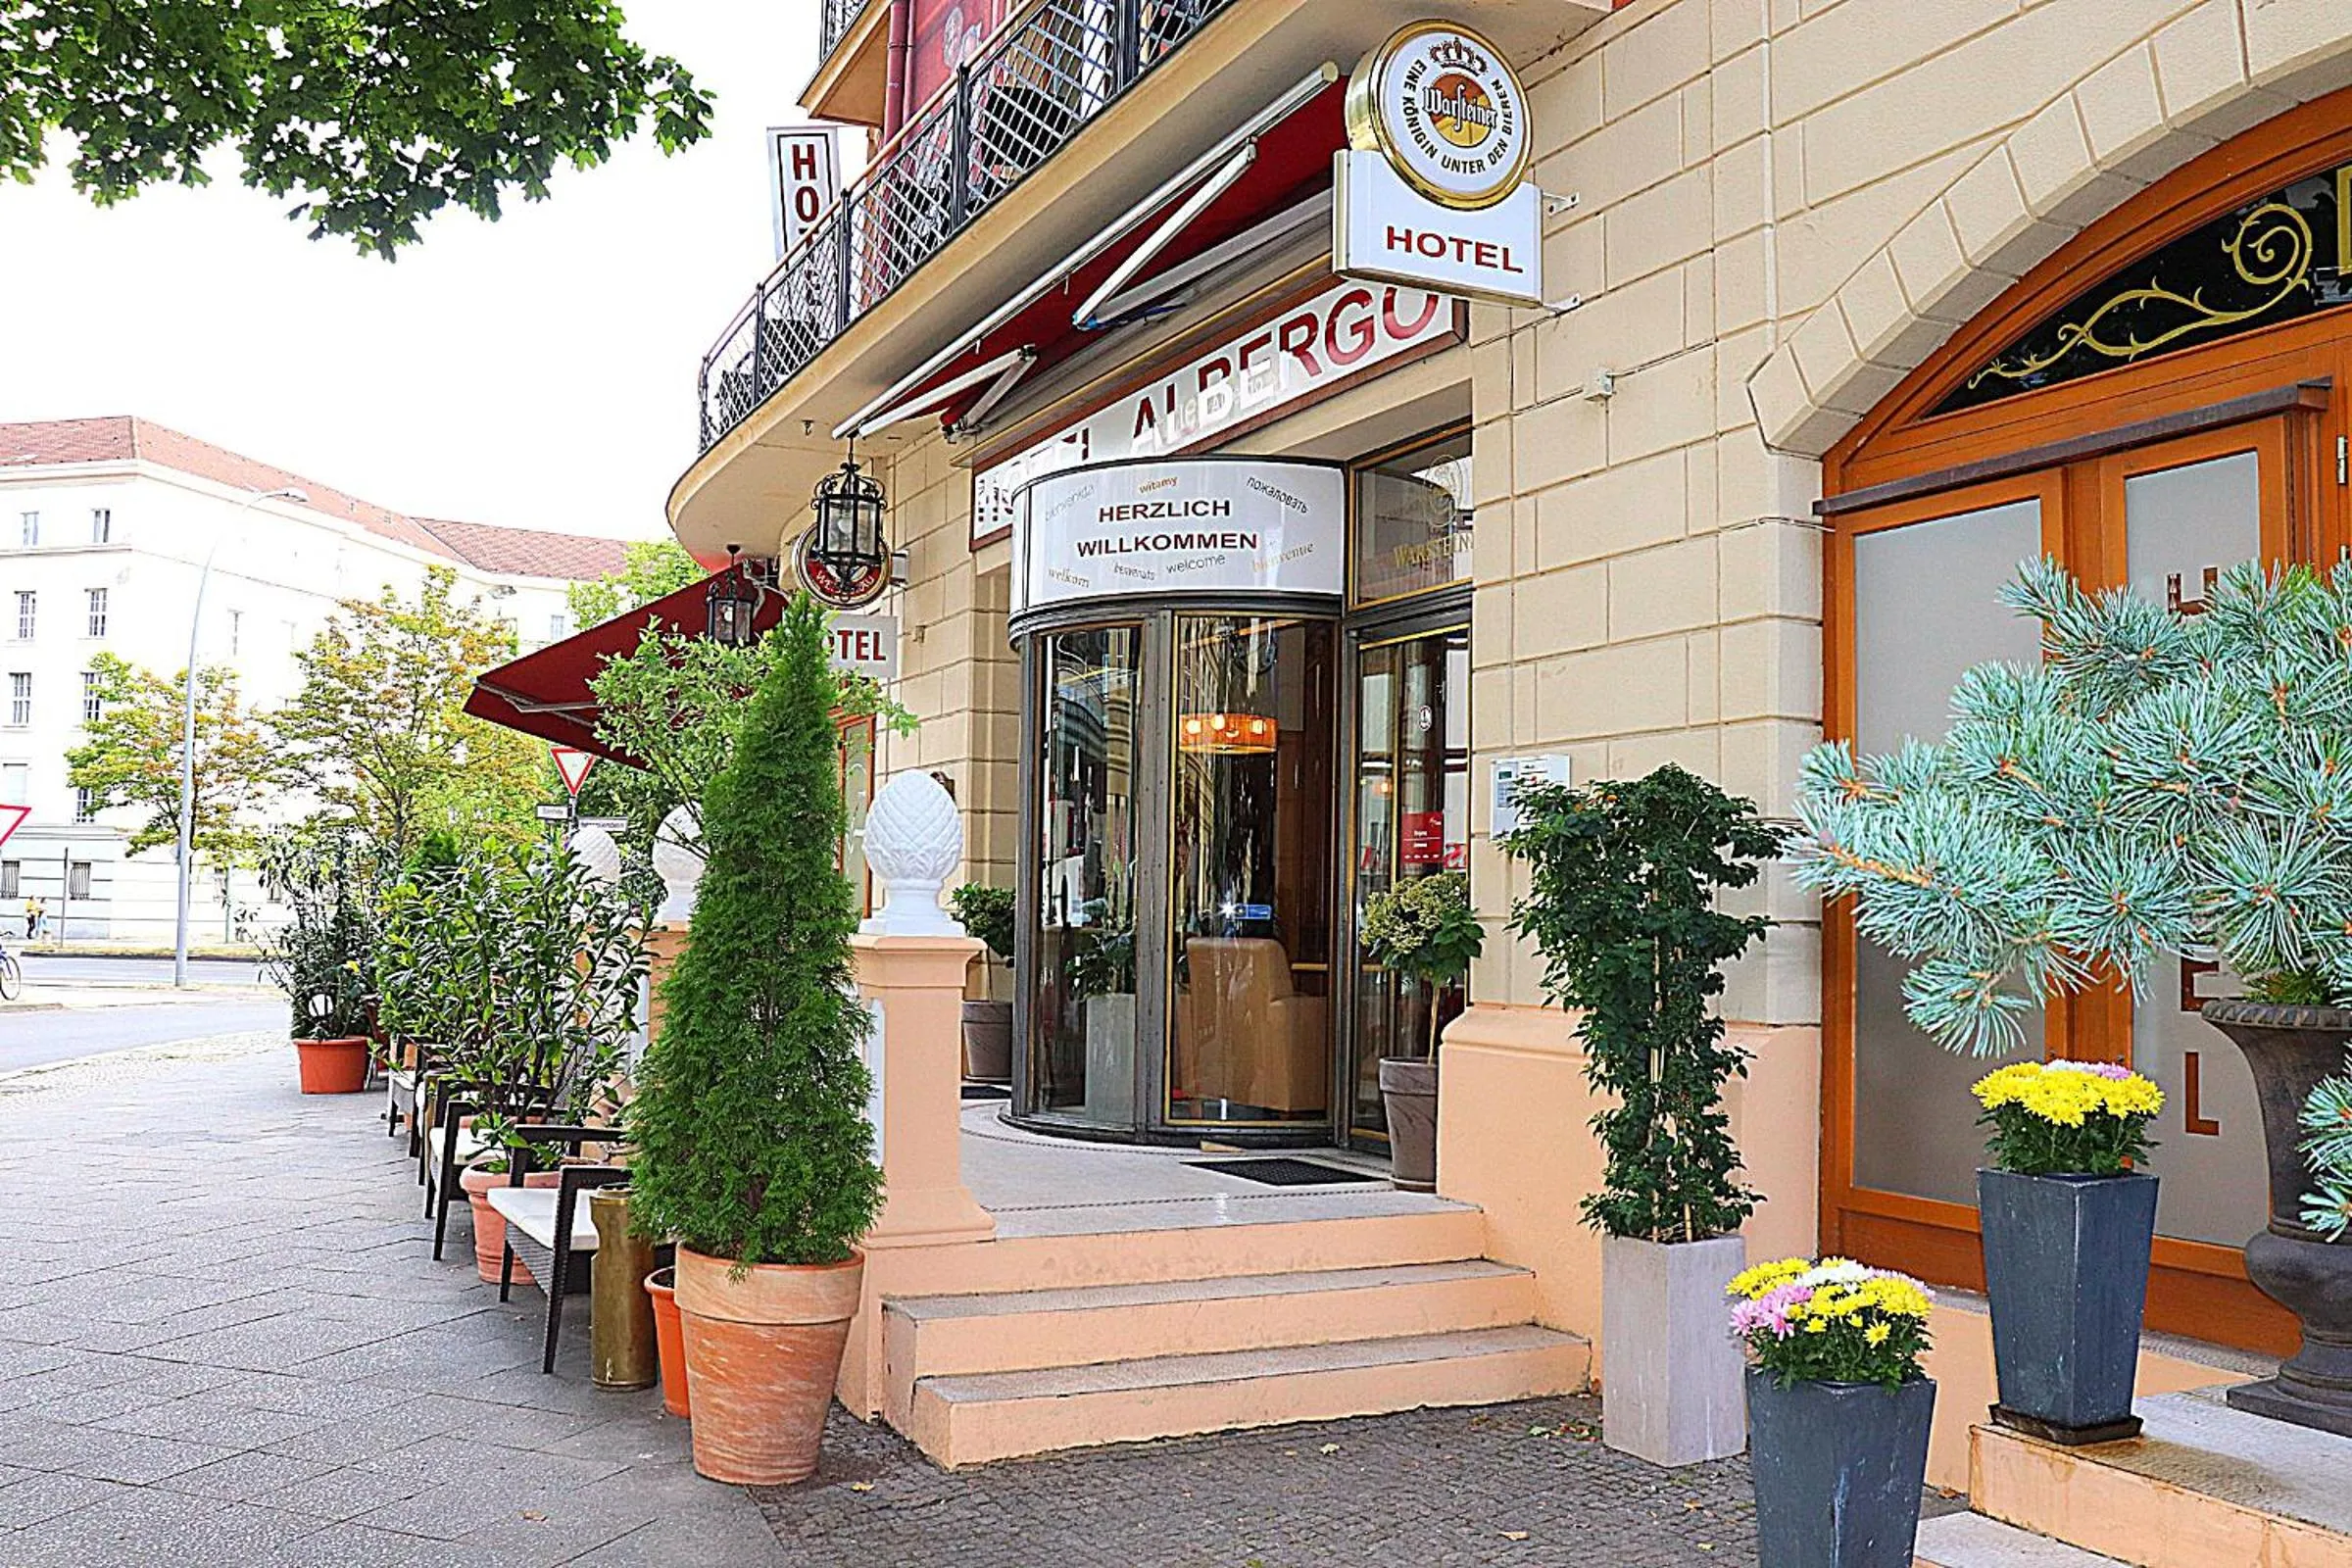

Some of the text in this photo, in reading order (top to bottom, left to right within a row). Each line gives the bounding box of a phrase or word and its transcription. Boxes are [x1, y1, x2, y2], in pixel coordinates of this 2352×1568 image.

[1403, 59, 1513, 174] EINE KÖNIGIN UNTER DEN BIEREN
[1422, 84, 1498, 132] Warsteiner
[1387, 225, 1524, 273] HOTEL
[1130, 285, 1440, 455] ALBERGO
[1140, 476, 1179, 494] witamy
[1246, 476, 1308, 514] пожаловать
[1099, 500, 1231, 523] HERZLICH
[1077, 533, 1257, 558] WILLKOMMEN
[1166, 554, 1226, 574] welcome
